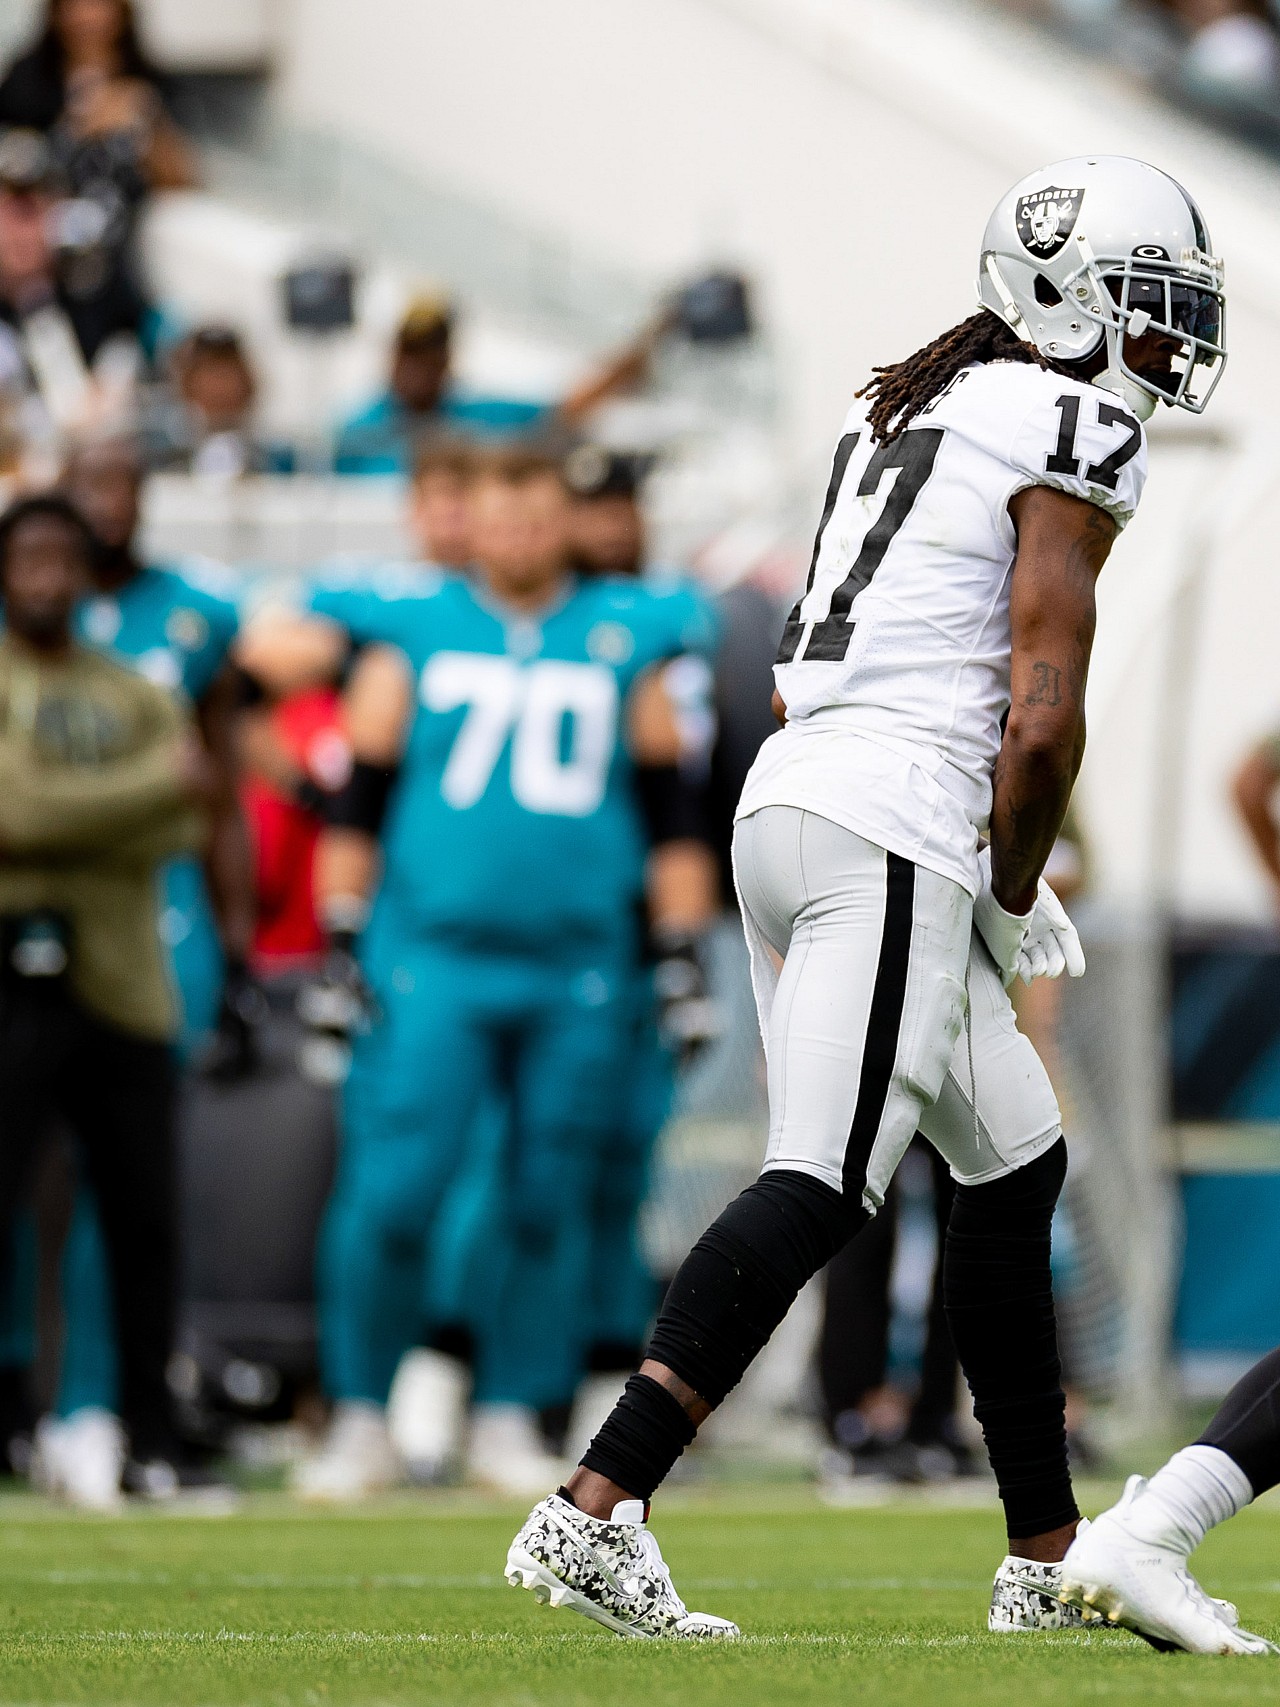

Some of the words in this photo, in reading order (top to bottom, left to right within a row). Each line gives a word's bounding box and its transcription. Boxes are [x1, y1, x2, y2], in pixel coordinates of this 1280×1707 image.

[1021, 189, 1079, 206] RAIDERS
[1045, 394, 1142, 491] 17
[775, 428, 945, 664] 17
[418, 648, 620, 818] 70
